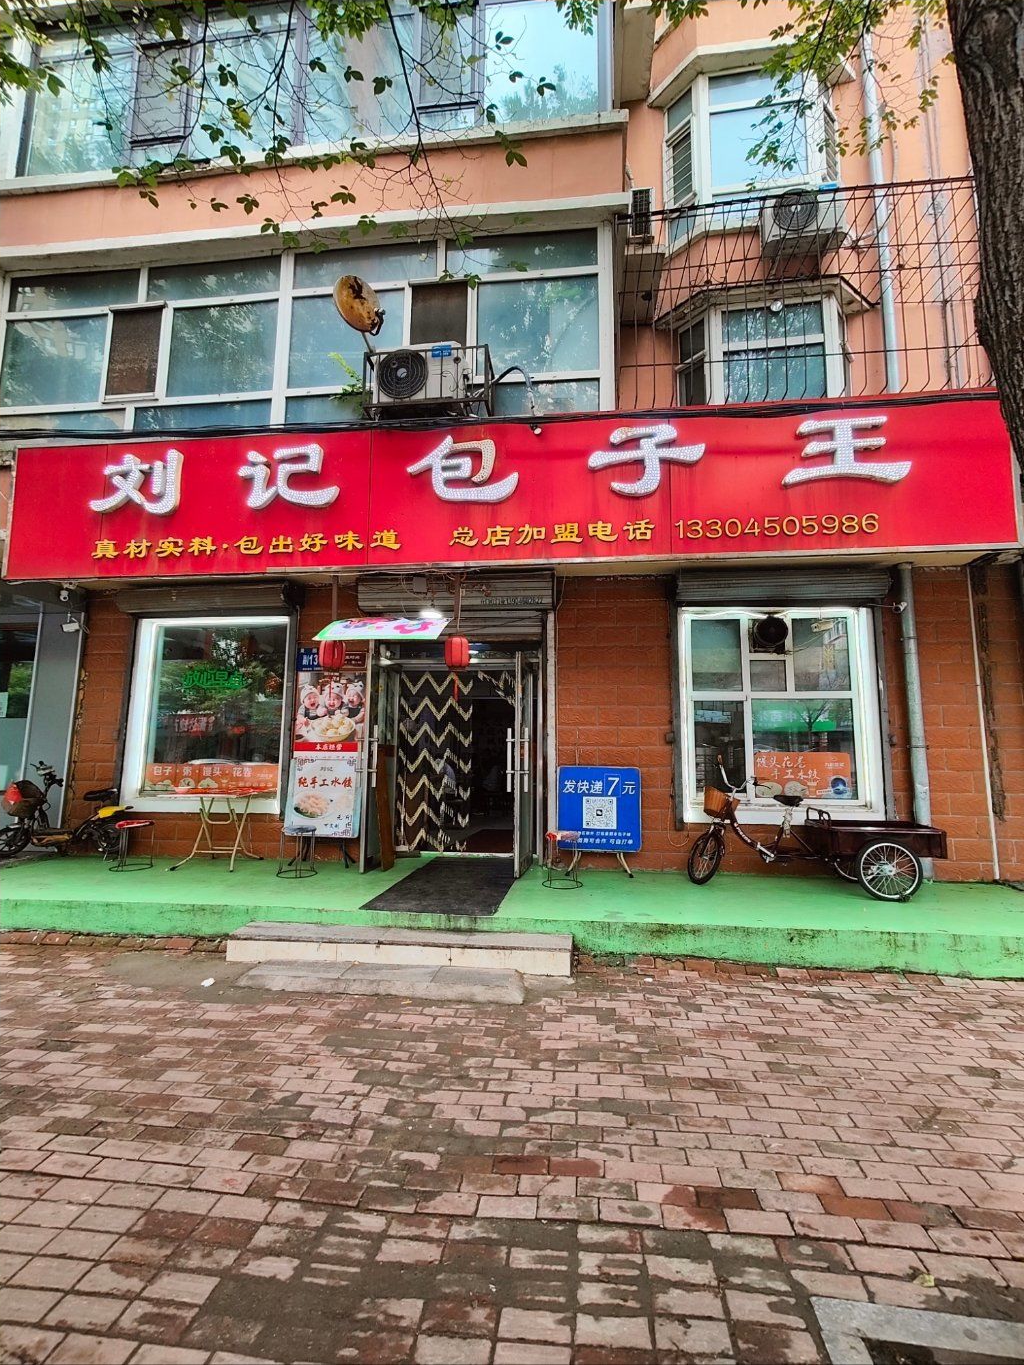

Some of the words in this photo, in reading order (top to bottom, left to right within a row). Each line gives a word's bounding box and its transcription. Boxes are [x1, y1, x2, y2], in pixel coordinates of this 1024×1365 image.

[89, 415, 913, 516] 刘记包子王
[449, 520, 656, 547] 总店加盟电话
[674, 514, 880, 540] 13304505986
[756, 755, 806, 768] 馒头花卷
[298, 776, 353, 788] 纯手工水饺
